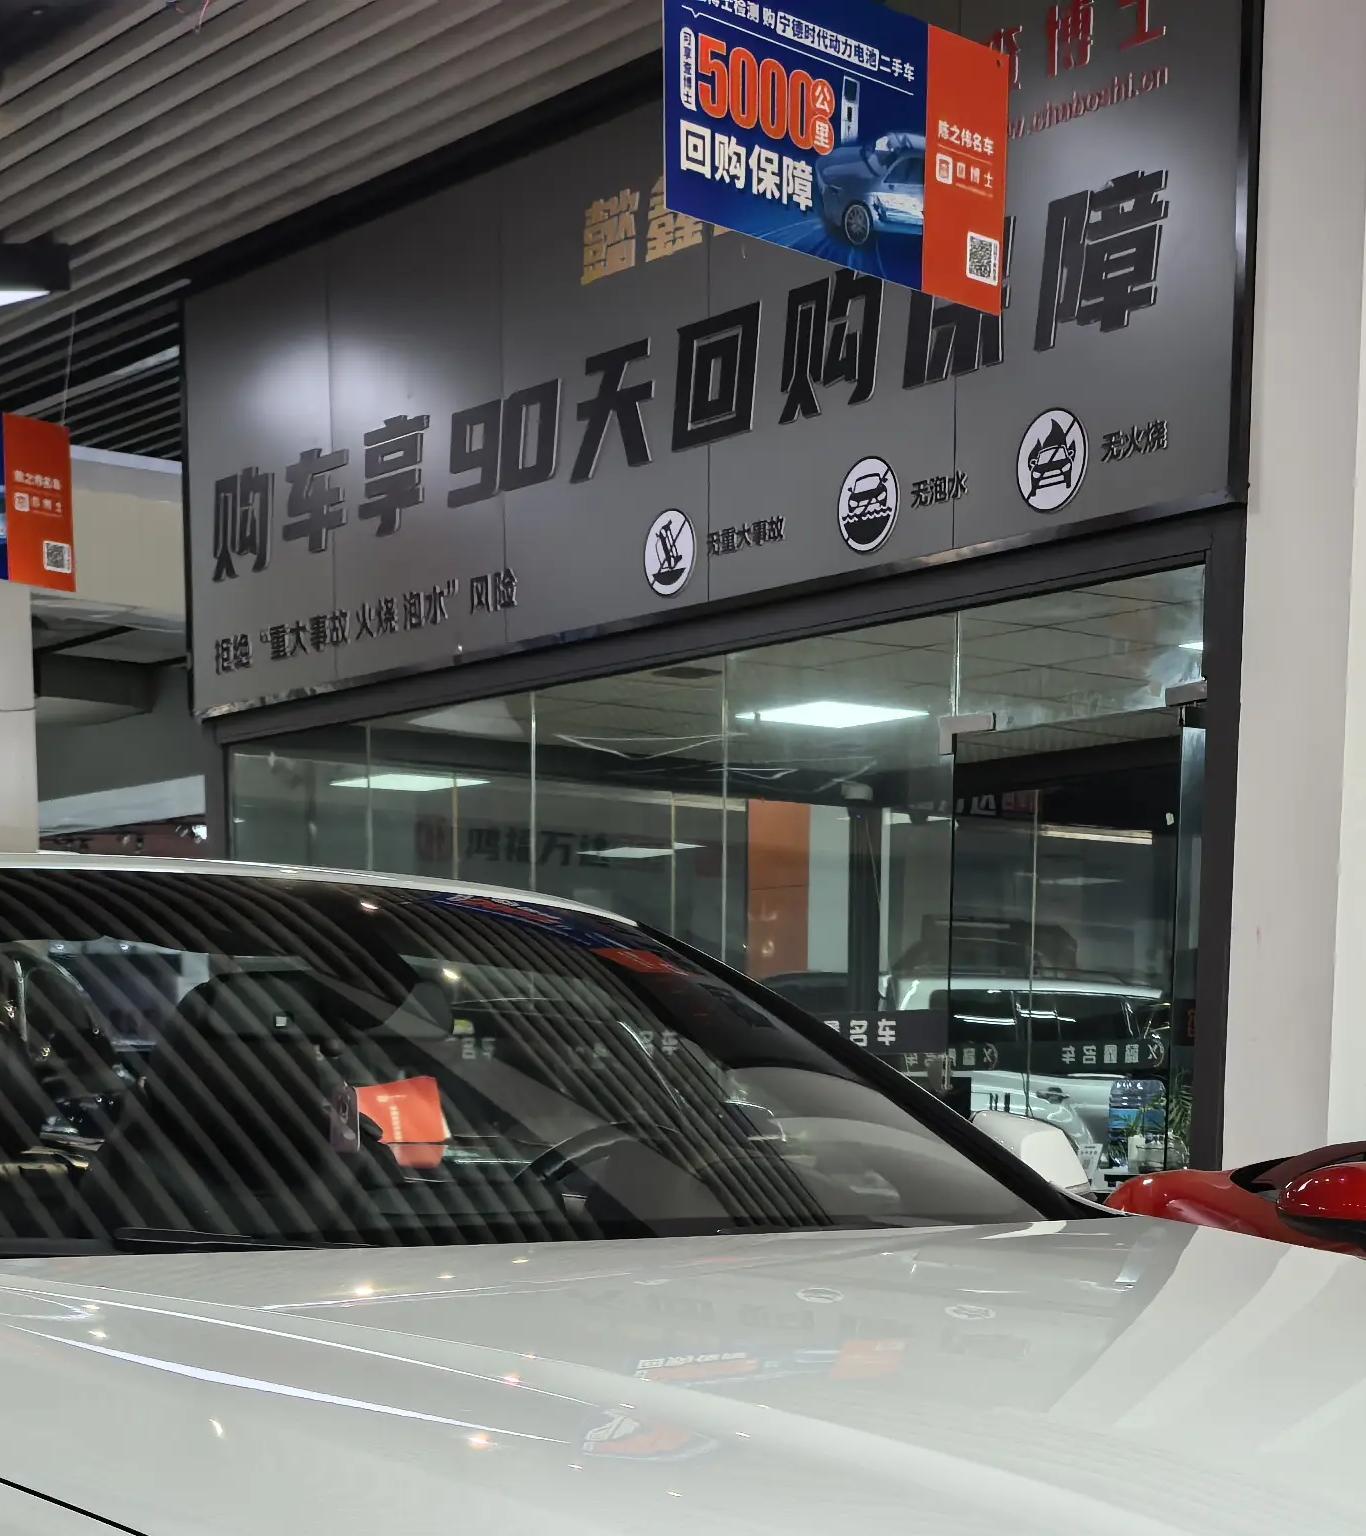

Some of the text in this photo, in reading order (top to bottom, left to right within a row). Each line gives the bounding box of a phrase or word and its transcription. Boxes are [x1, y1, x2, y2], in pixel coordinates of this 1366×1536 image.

[680, 119, 814, 212] 回购保障
[1100, 419, 1169, 465] 无火烧
[911, 470, 968, 509] 无泡水
[469, 568, 519, 615] 风险
